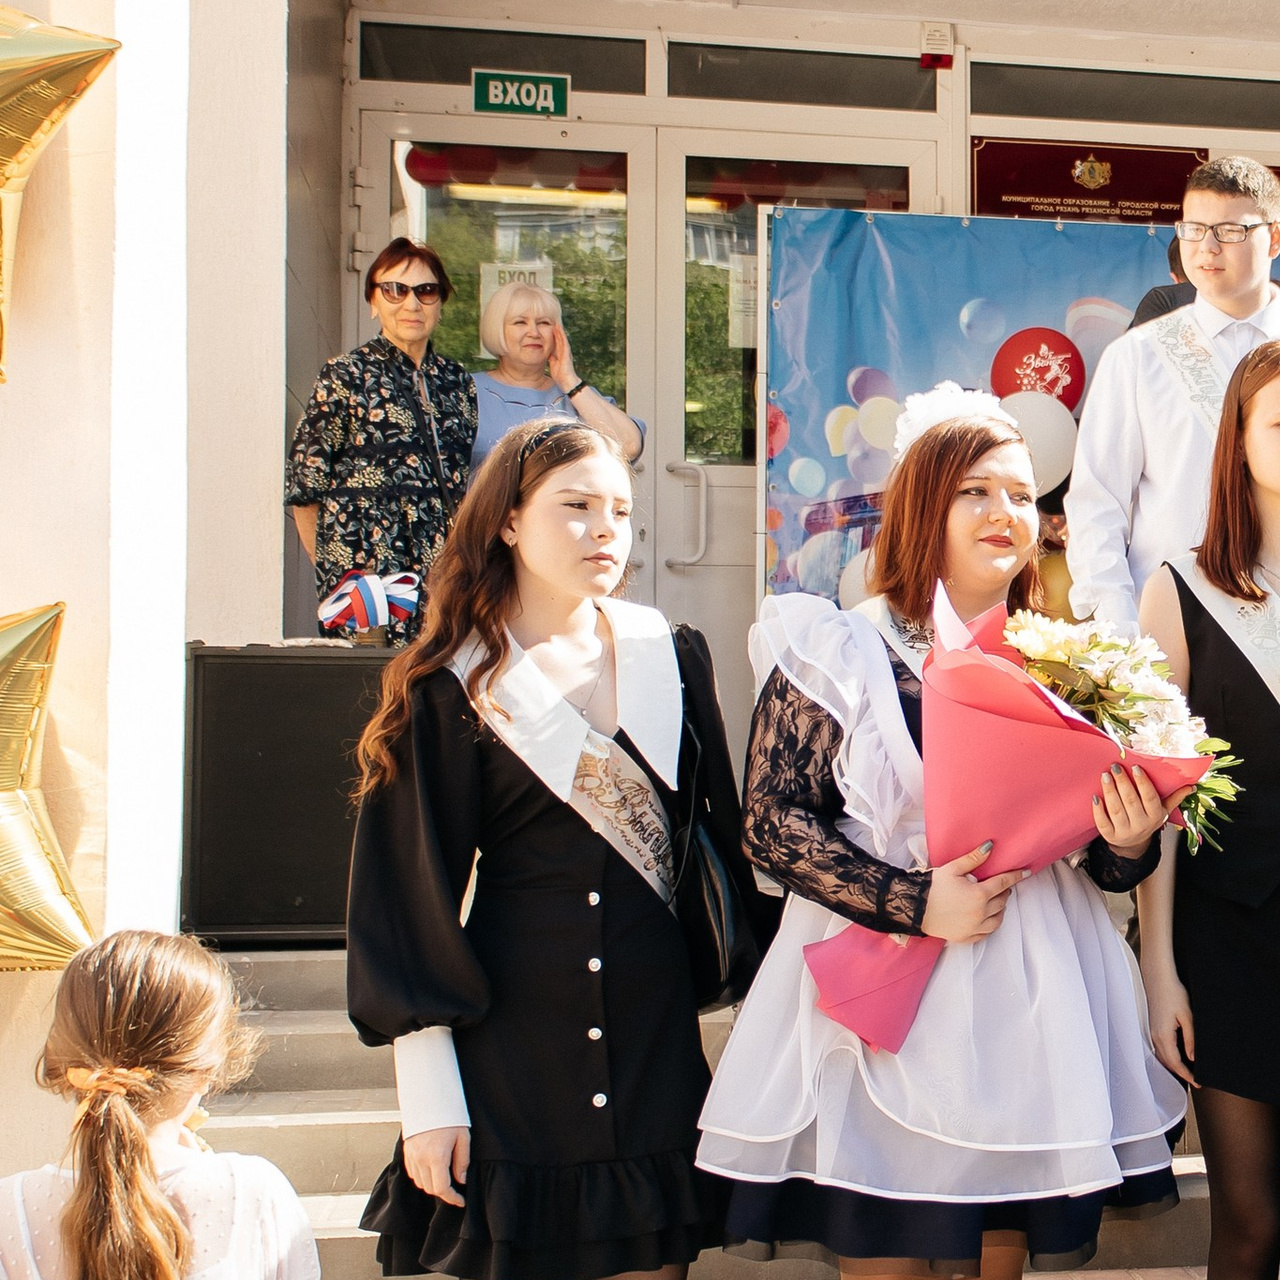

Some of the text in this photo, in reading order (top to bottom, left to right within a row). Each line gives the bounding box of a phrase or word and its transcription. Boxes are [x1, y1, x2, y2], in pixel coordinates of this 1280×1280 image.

[488, 80, 555, 112] ВХОД
[1002, 195, 1061, 205] МУНИЦИПАЛЬНОЕ
[1063, 198, 1110, 207] ОБРАЗОВАНИЕ
[1117, 200, 1159, 209] ГОРОДСКОЙ
[1161, 203, 1181, 211] ОКРУГ
[1031, 204, 1153, 217] ГОРОД РЯЗАНЬ РЯЗАНСКОЙ ОБЛАСТИ
